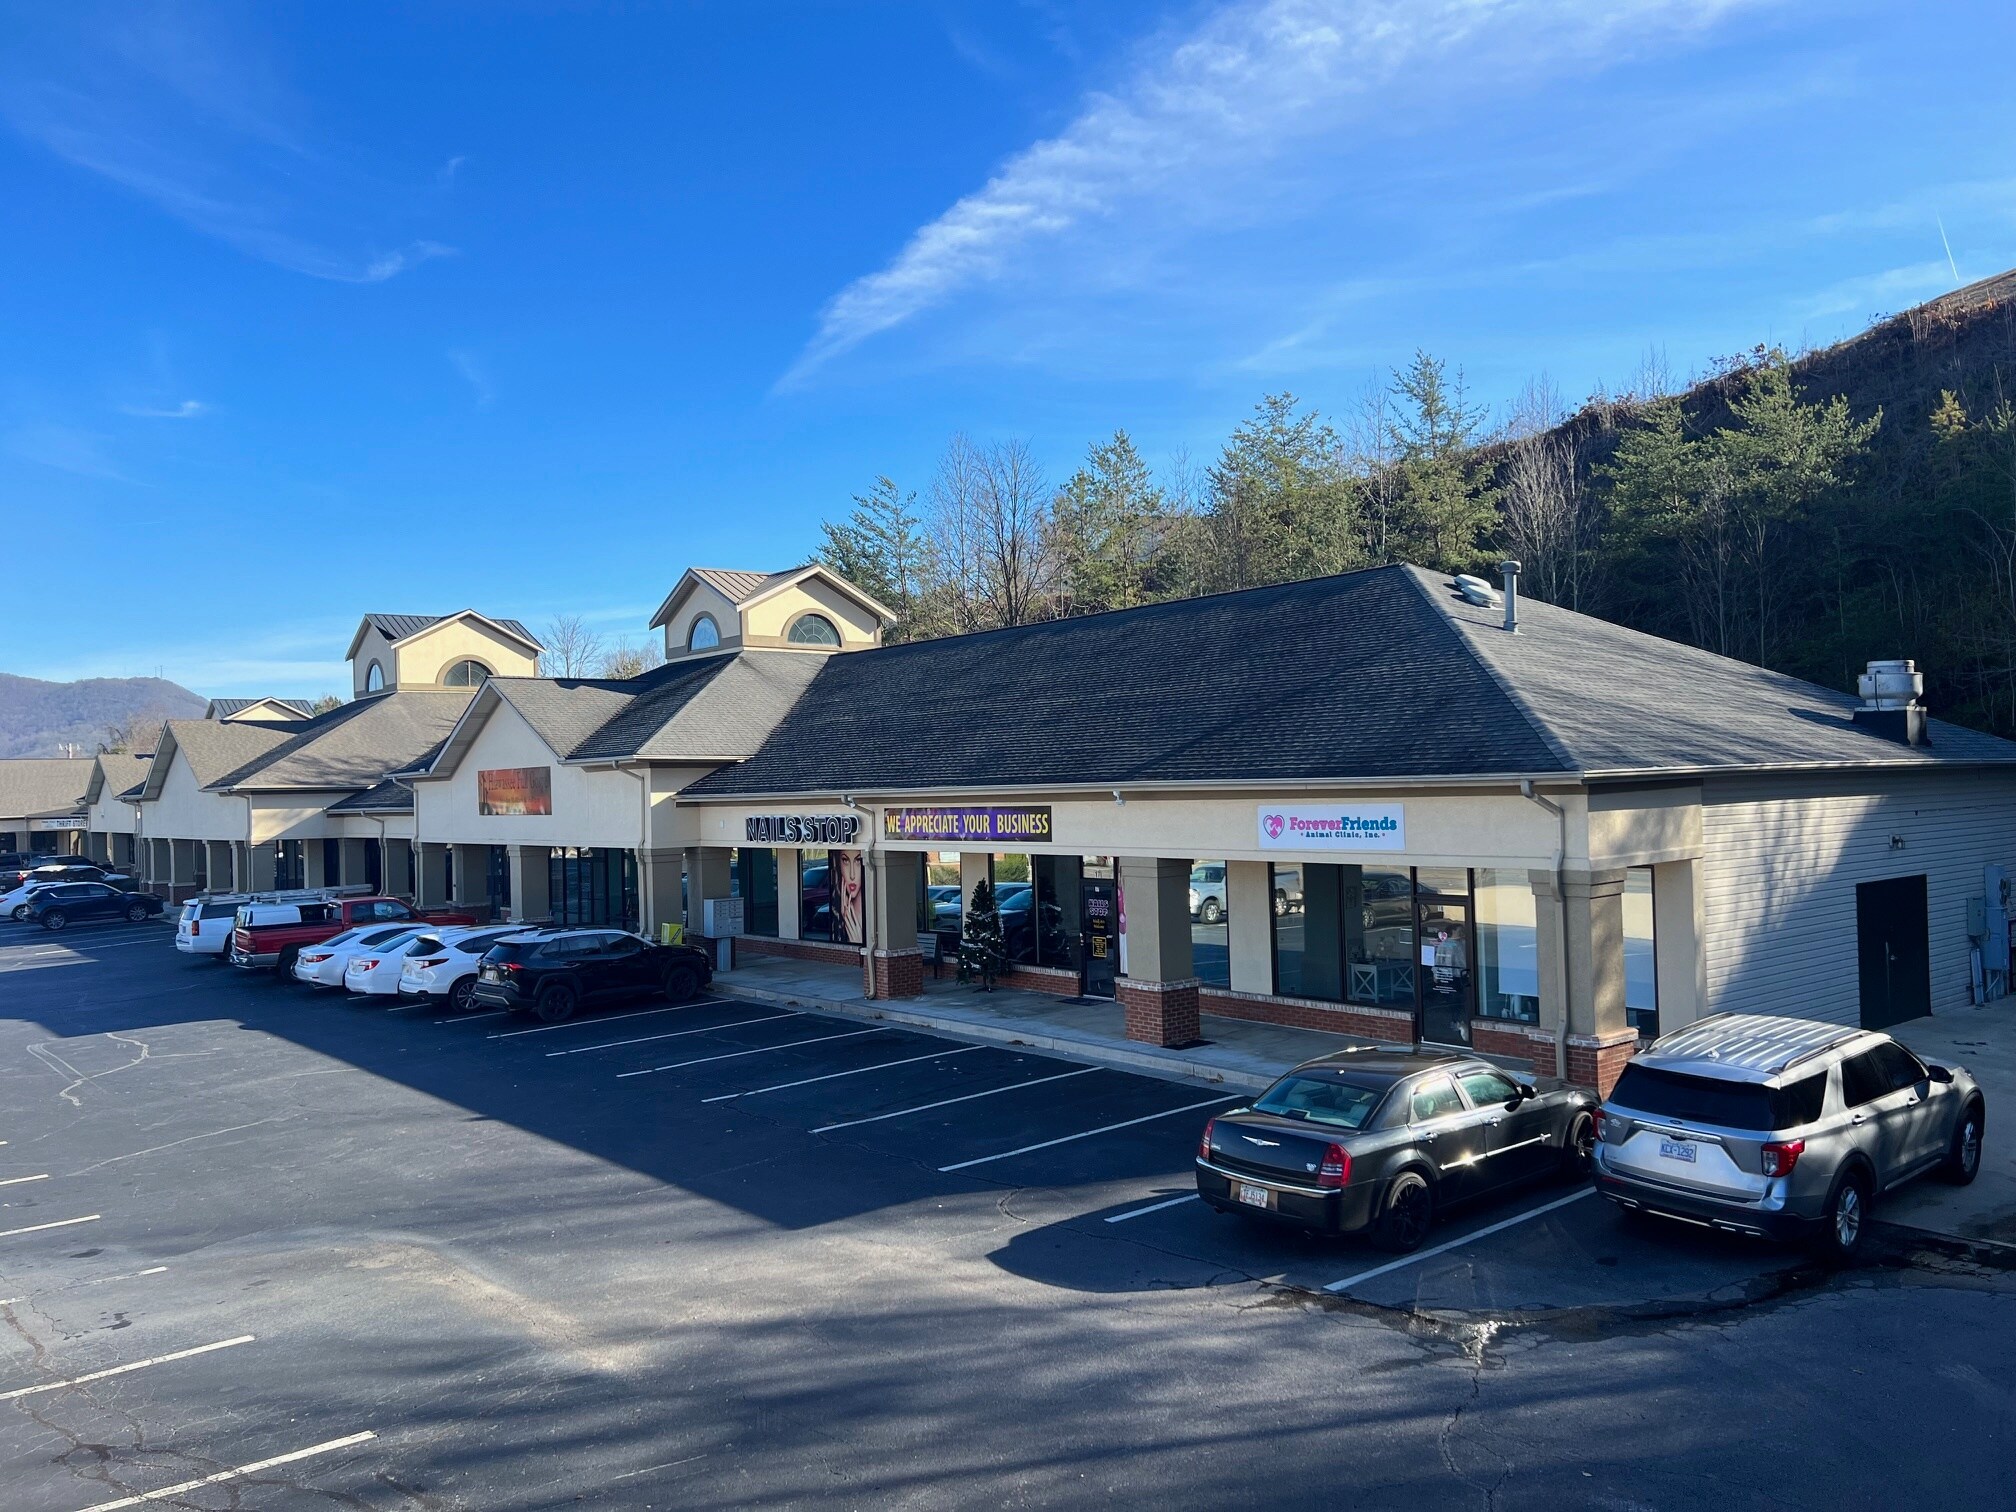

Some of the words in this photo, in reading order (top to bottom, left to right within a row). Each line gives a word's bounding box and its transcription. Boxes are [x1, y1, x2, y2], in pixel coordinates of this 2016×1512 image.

[746, 816, 802, 842] NAILS
[803, 815, 859, 844] STOP
[887, 816, 900, 832] WE
[905, 815, 959, 833] APPRECIATE
[963, 814, 990, 833] YOUR
[997, 814, 1049, 833] BUSINESS
[1088, 899, 1109, 908] NAILS
[1089, 907, 1109, 916] STOP
